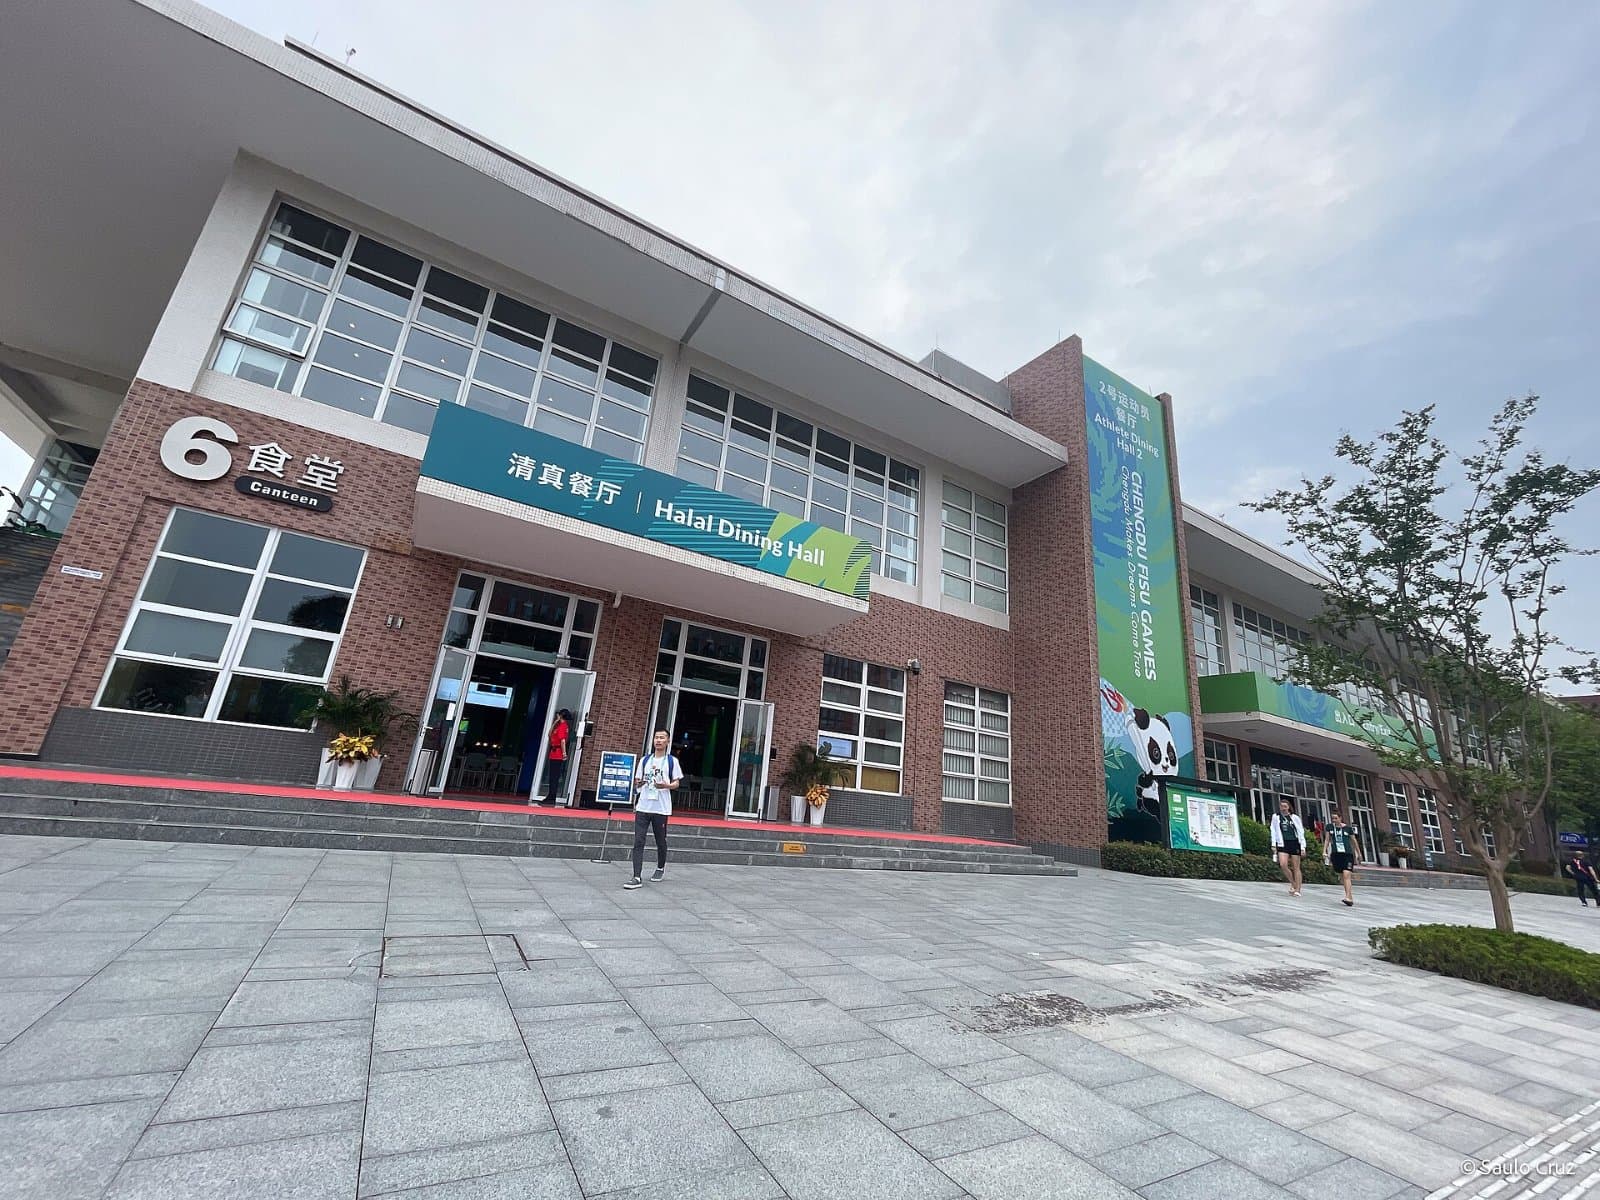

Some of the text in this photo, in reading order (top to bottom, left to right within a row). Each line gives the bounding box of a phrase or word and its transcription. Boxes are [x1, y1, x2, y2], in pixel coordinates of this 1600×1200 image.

[1094, 412, 1160, 458] Athlete Dining
[1116, 406, 1137, 429] 餐厅
[159, 415, 239, 481] 6
[247, 441, 345, 494] 食堂
[1117, 436, 1143, 460] Hall 2
[250, 480, 319, 507] Canteen
[505, 452, 623, 506] 清真餐厅
[1121, 465, 1131, 517] Chengdu
[654, 499, 825, 567] Halal Dining Hall
[1125, 519, 1134, 557] Makes
[1127, 562, 1136, 609] Dreams
[1131, 471, 1156, 681] CHENGDU FISU GAMES
[1131, 612, 1140, 648] Come
